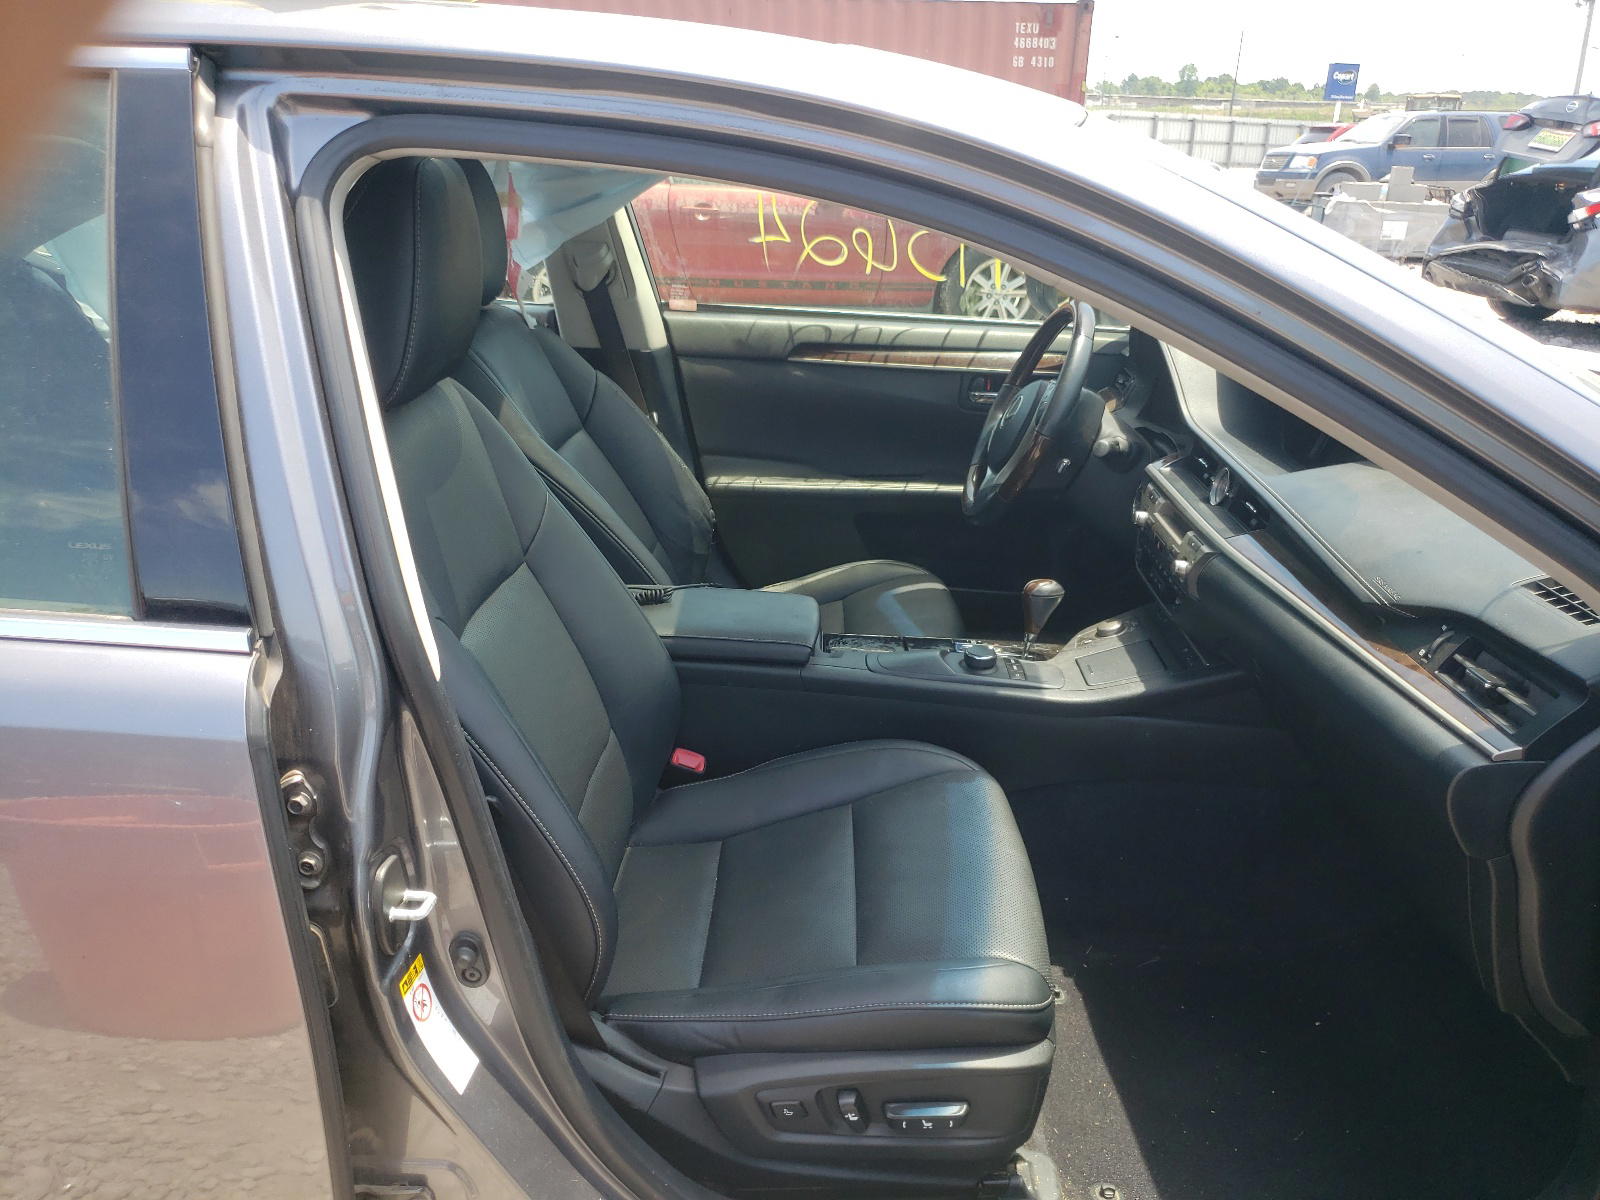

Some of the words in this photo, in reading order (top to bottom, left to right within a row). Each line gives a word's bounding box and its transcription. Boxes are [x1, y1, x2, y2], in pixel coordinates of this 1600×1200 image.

[1015, 22, 1040, 34] TEXU
[1013, 37, 1057, 49] 4668403
[1030, 56, 1055, 68] 4310
